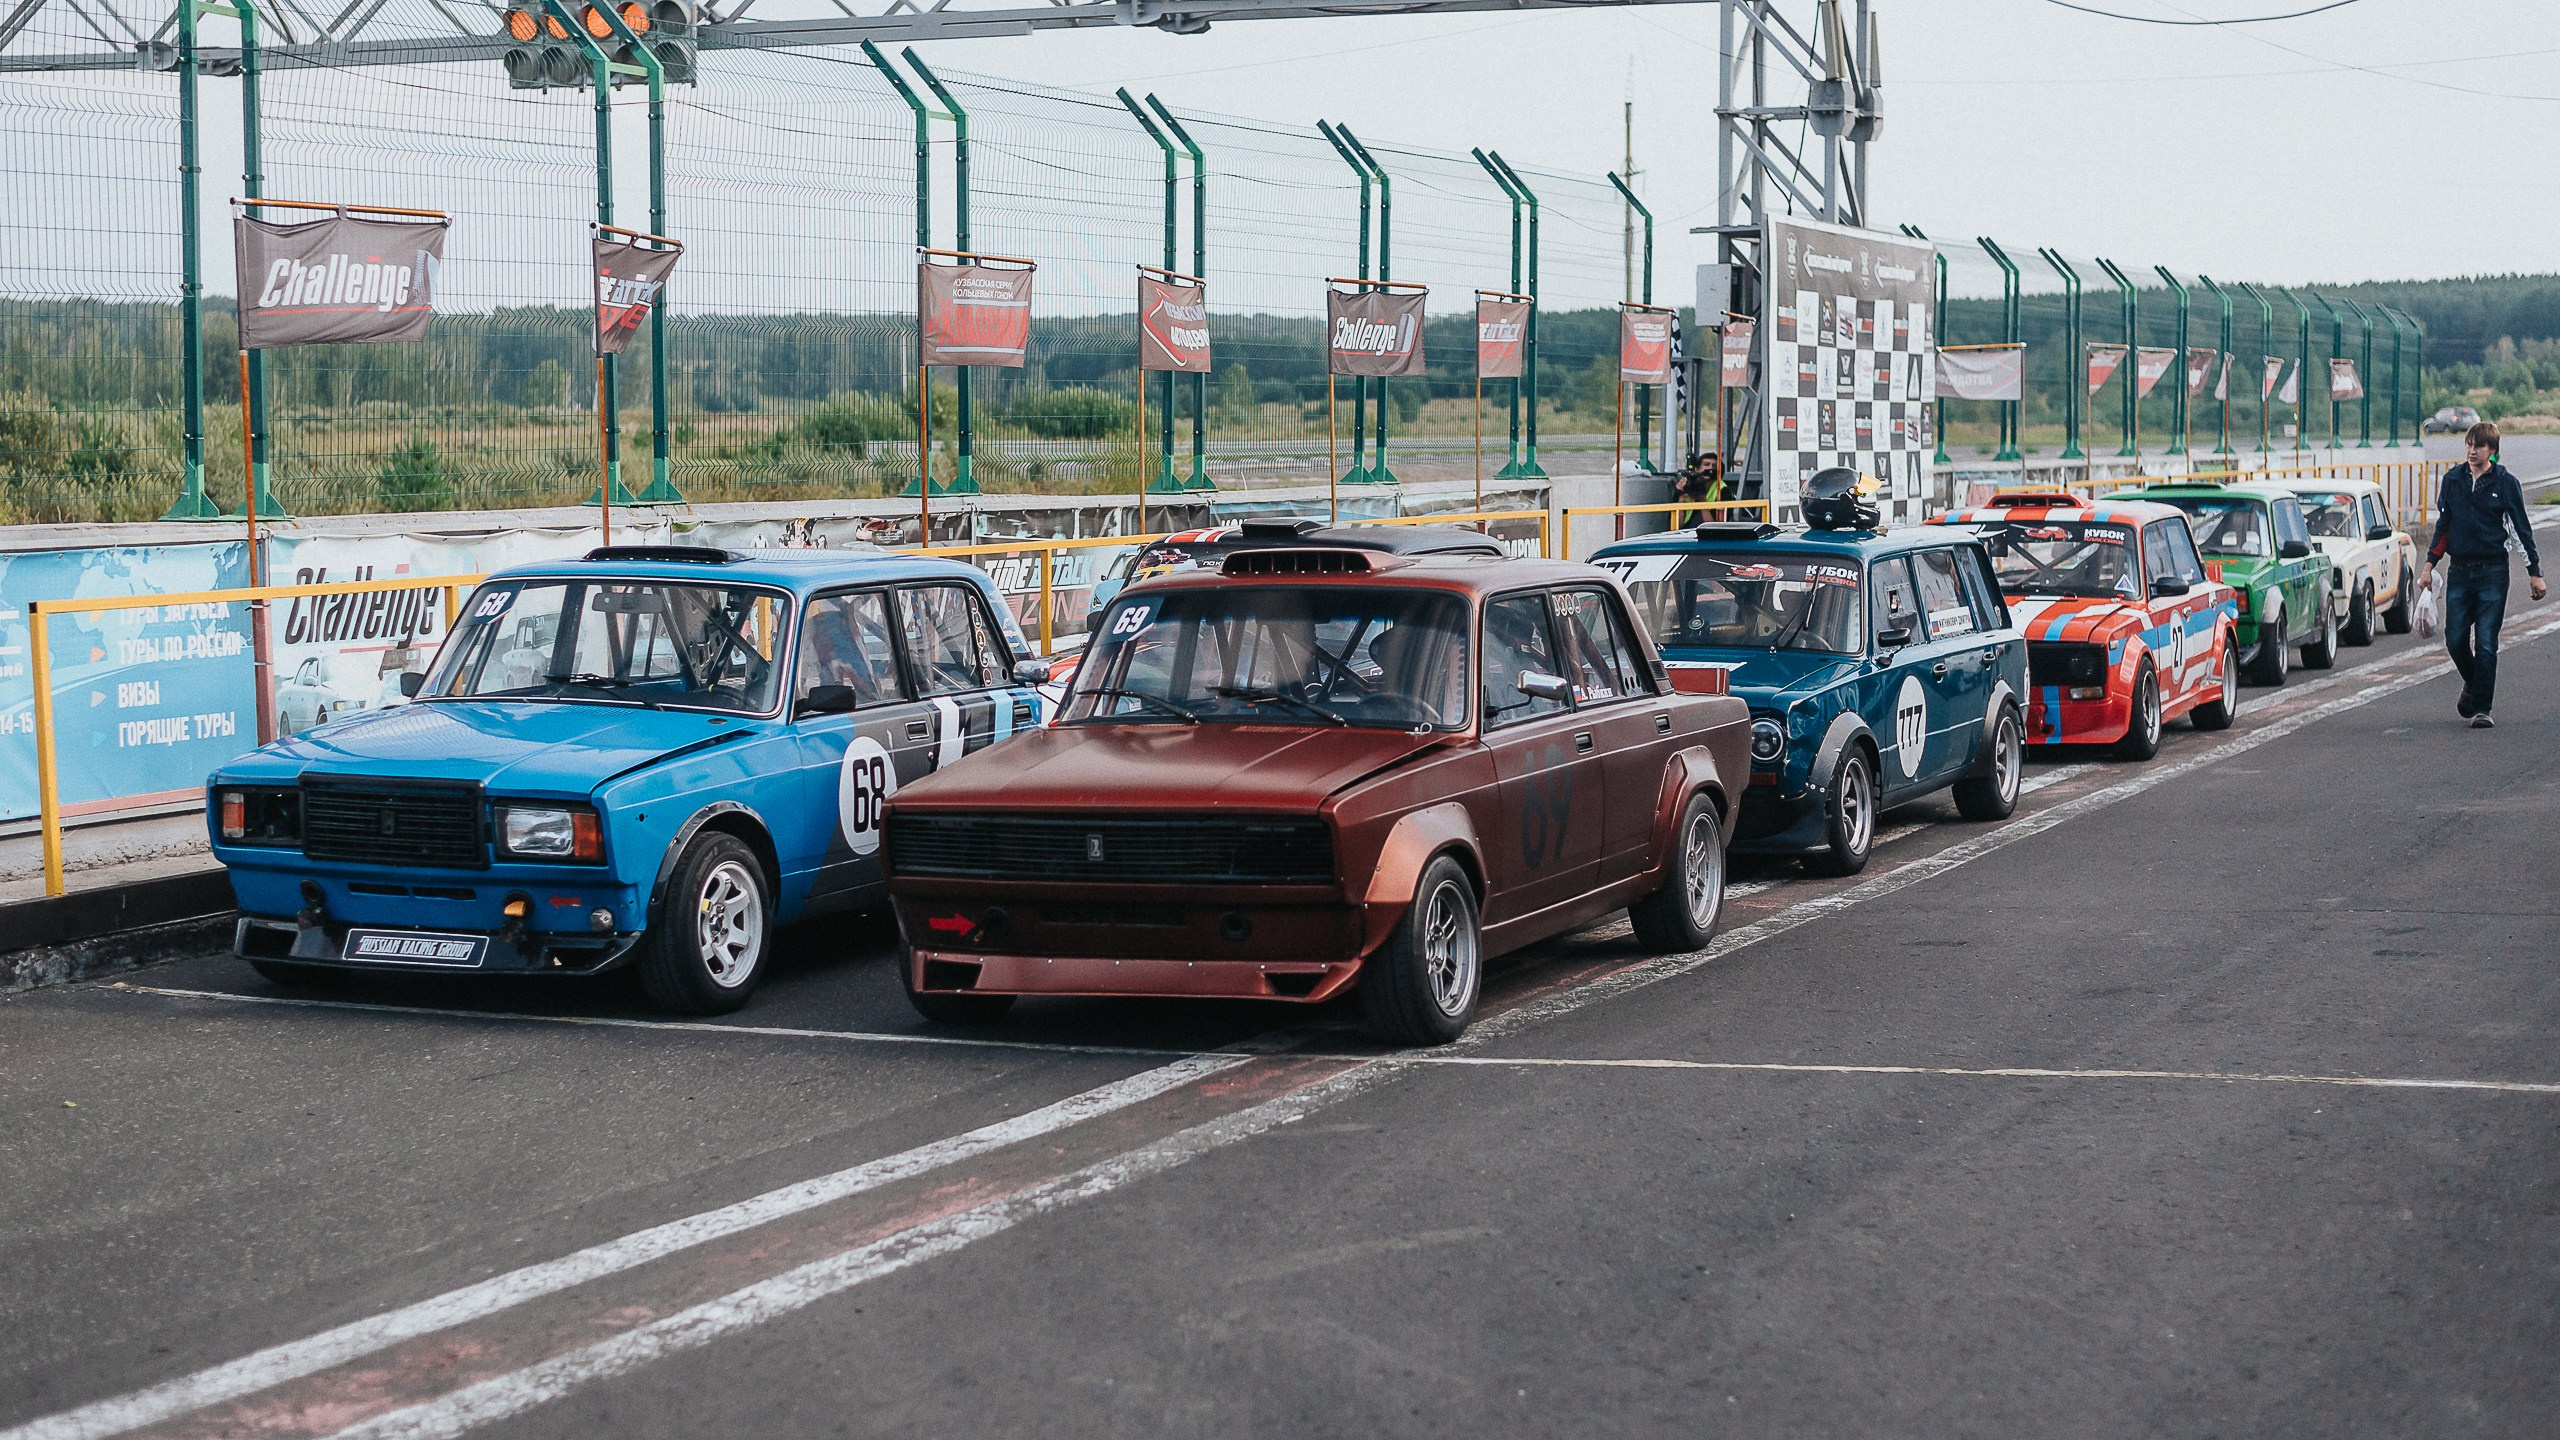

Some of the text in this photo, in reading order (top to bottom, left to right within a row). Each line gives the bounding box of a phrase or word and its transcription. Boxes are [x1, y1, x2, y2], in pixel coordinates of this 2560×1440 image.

[258, 253, 412, 313] Challenge
[952, 288, 994, 299] КОЛЬЦЕВЫХ
[1332, 316, 1397, 356] Challenge
[1028, 555, 1094, 588] ATACK
[1805, 564, 1859, 582] КУБОК
[284, 565, 439, 650] Challenge
[474, 591, 512, 618] 68
[1020, 589, 1092, 626] ZNE
[1113, 605, 1150, 635] 69
[118, 631, 241, 664] ТУРЫ ПО РОССИИ
[2172, 625, 2183, 668] 27
[118, 680, 160, 708] ВИЗЫ
[119, 711, 235, 747] ГОРЯЩИЕ ТУРЫ
[1899, 704, 1923, 750] 777
[852, 755, 886, 834] 68
[1522, 744, 1573, 871] 69
[360, 937, 473, 958] RUSSIAN RACING GROUP
